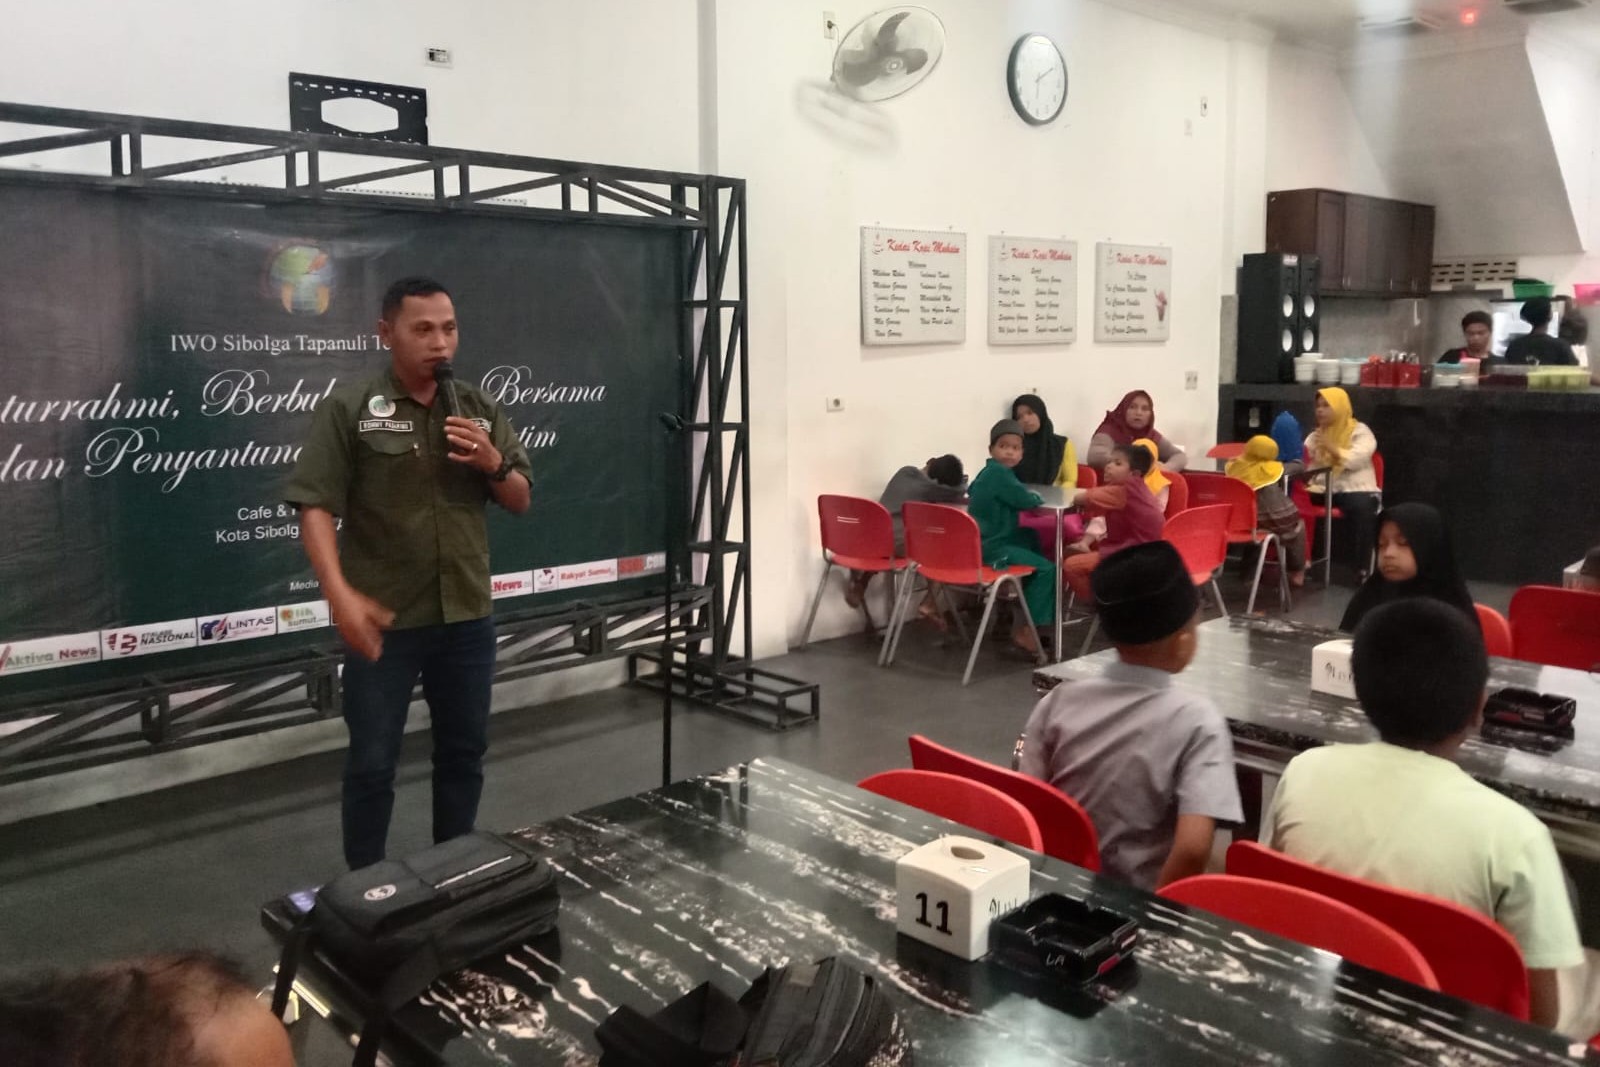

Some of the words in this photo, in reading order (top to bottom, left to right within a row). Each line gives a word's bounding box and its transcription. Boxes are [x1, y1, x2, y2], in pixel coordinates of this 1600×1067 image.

[170, 334, 217, 352] IWO
[222, 334, 291, 356] Sibolga
[295, 334, 368, 356] Tapanuli
[480, 365, 608, 406] Bersama
[237, 505, 273, 521] Cafe
[276, 503, 288, 517] &
[215, 528, 251, 544] Kota
[254, 523, 300, 539] Sibolg
[289, 579, 320, 592] Media
[493, 579, 523, 592] News
[228, 615, 274, 630] LINTAS
[140, 631, 196, 646] NASIONAL
[58, 646, 98, 660] News
[915, 891, 953, 936] 11
